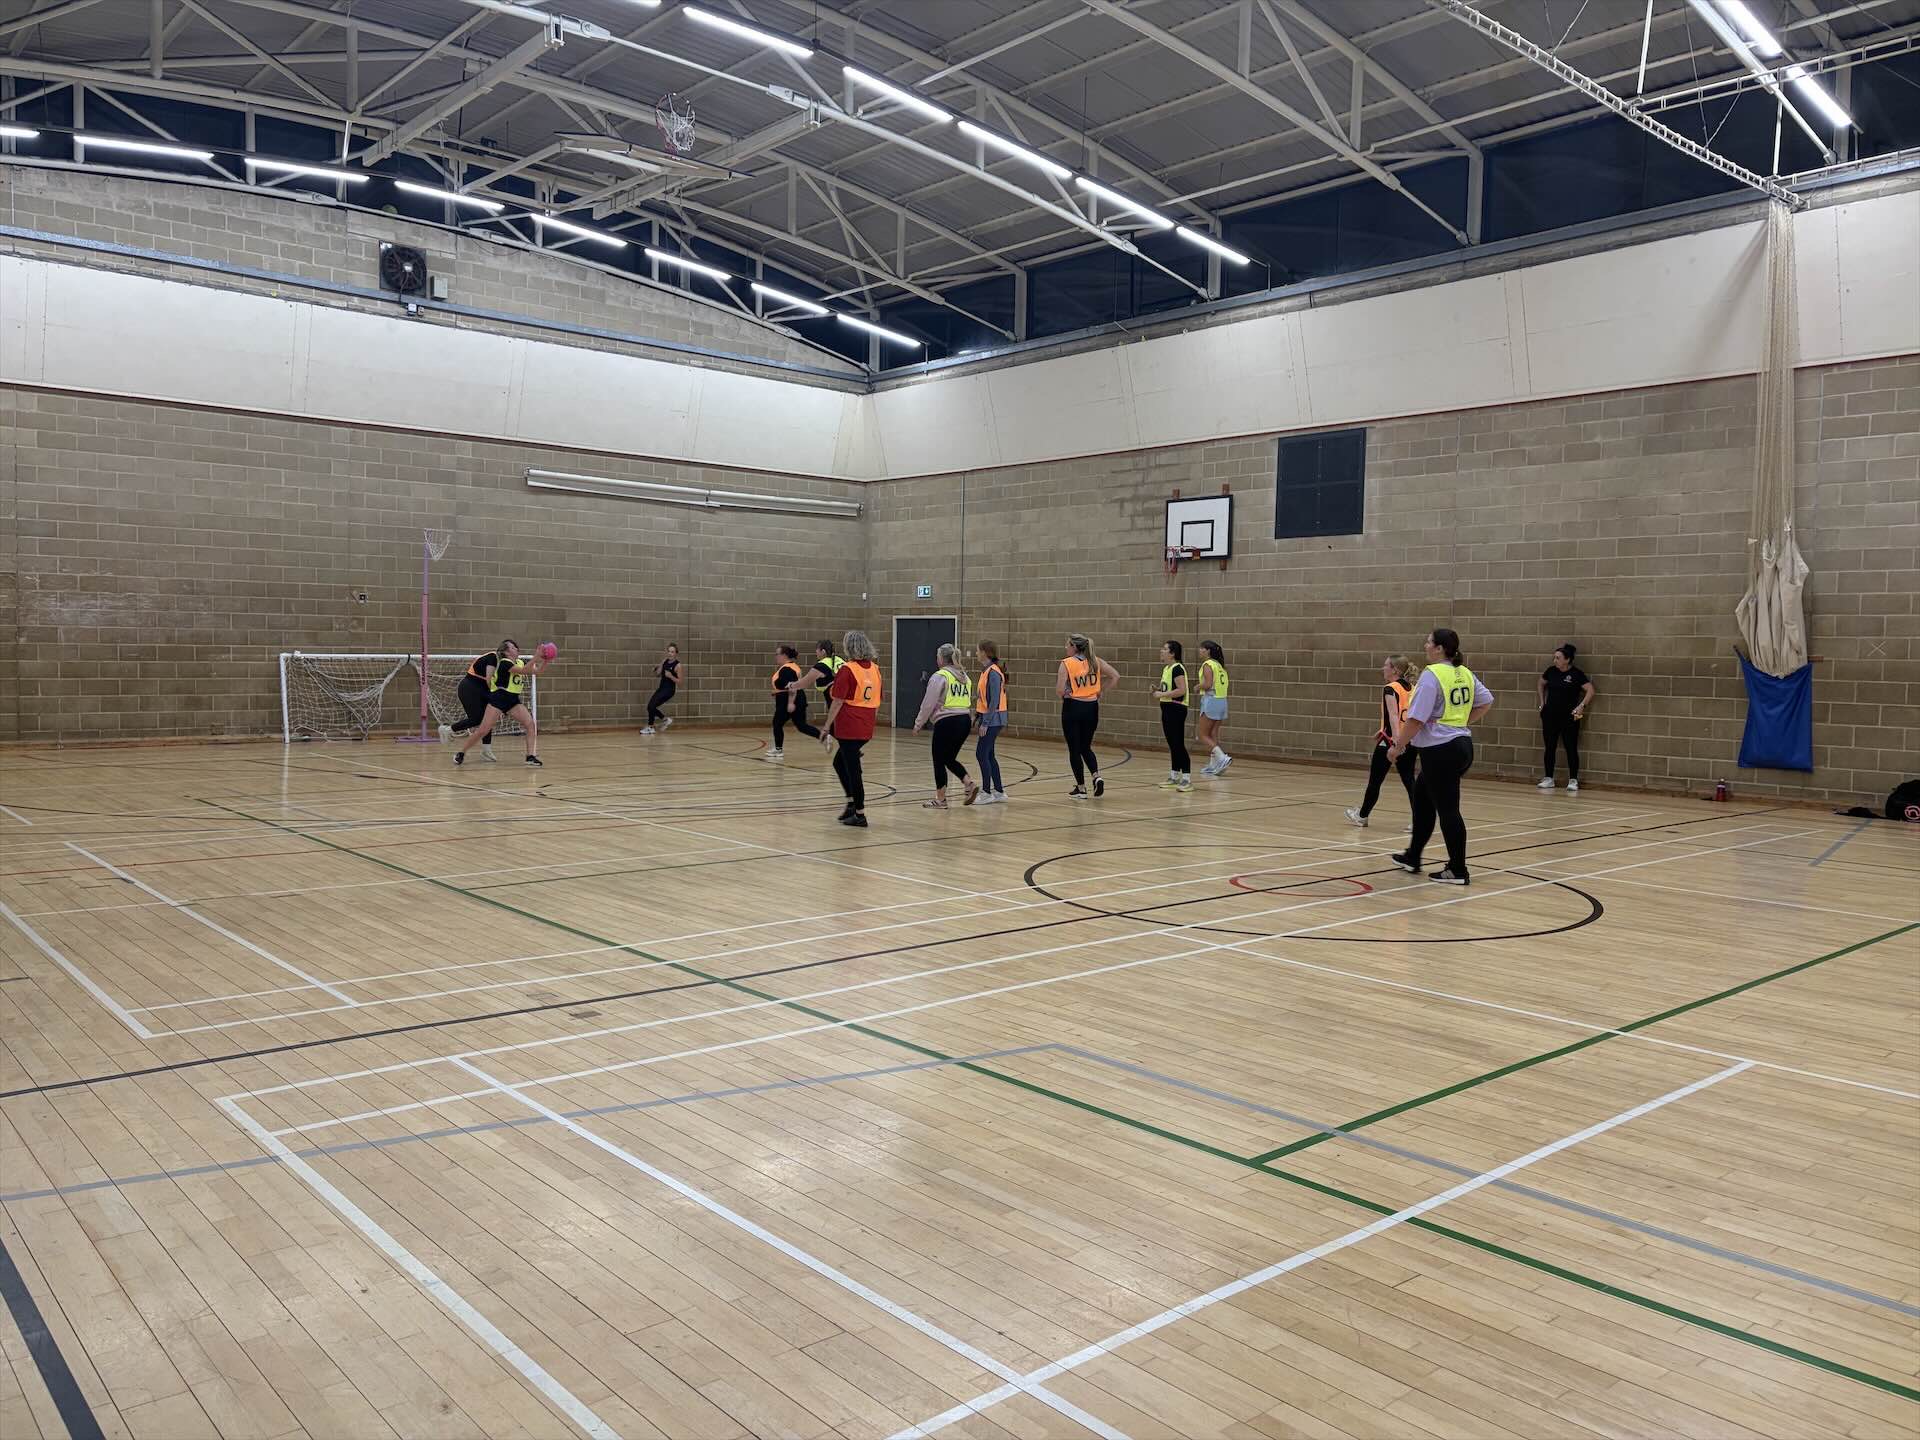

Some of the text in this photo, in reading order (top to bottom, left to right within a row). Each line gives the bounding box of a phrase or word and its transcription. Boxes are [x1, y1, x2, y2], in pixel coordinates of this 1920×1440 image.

[1074, 674, 1097, 688] WD
[864, 687, 873, 699] C
[950, 684, 969, 697] WA
[1451, 687, 1470, 705] GD
